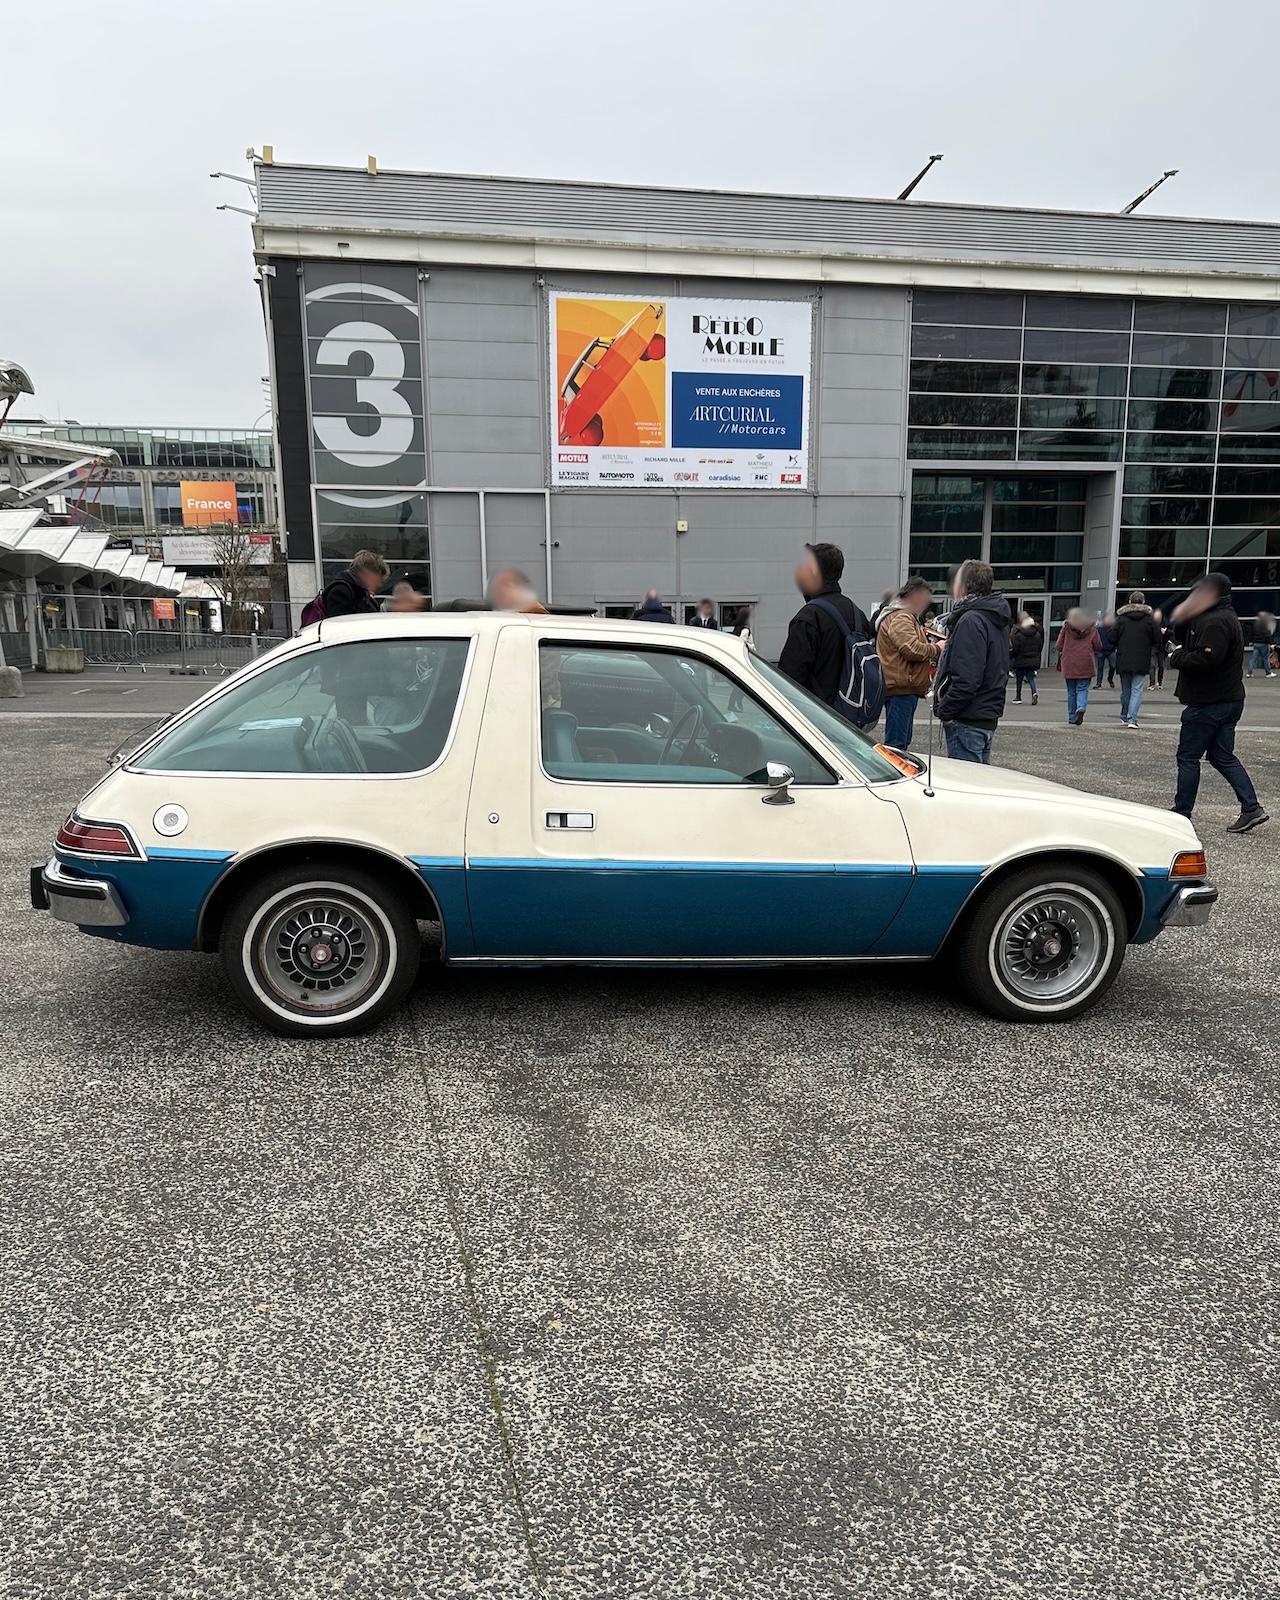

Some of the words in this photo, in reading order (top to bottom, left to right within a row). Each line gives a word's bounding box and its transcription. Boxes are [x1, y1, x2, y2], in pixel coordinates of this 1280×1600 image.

[702, 336, 785, 356] MOBILE
[313, 321, 414, 467] 3
[695, 387, 720, 396] VENTE
[721, 388, 738, 396] AUX
[739, 387, 781, 398] ENCHÈRES
[689, 405, 776, 422] ARTCURIAL
[718, 423, 787, 435] //Motorcars
[559, 454, 588, 462] MOTUL
[187, 499, 232, 510] France
